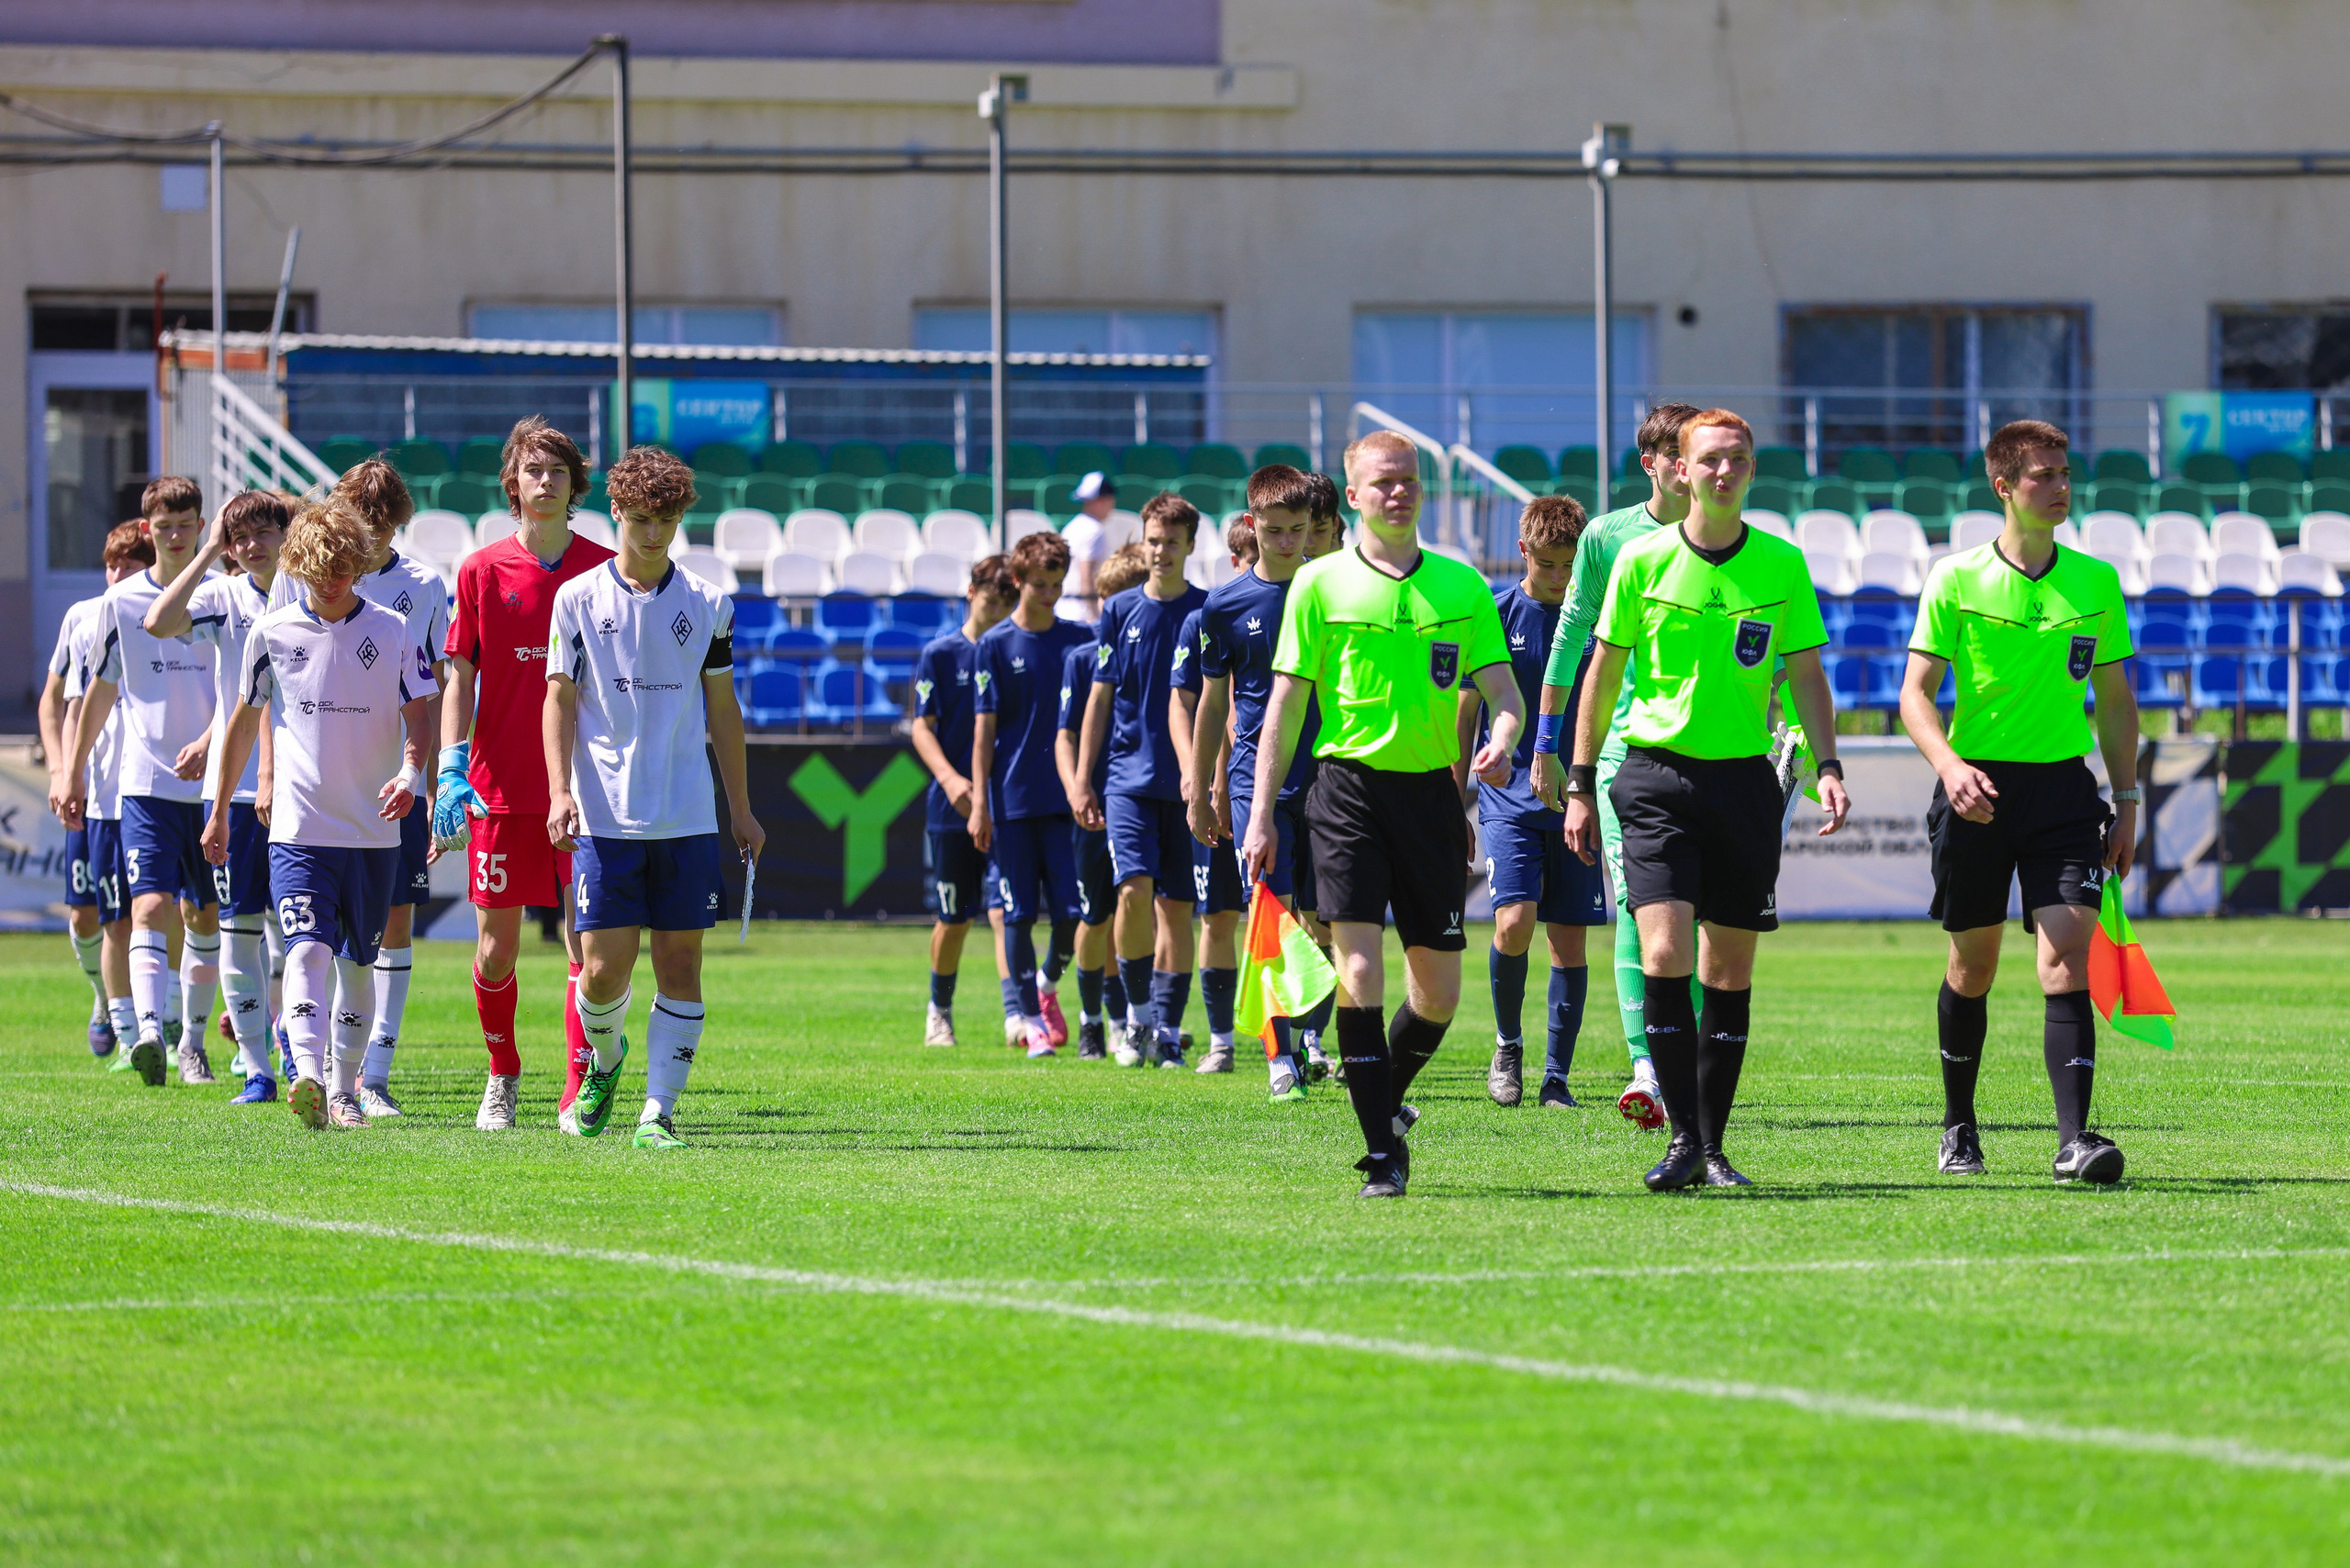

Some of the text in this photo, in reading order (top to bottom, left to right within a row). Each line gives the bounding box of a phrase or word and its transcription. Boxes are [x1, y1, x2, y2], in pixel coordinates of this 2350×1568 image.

[1742, 624, 1768, 633] РОССИЯ
[318, 706, 371, 714] ТРАНССТРОЙ
[476, 850, 508, 893] 35
[576, 873, 590, 914] 4
[936, 880, 957, 915] 17
[999, 877, 1013, 913] 9
[279, 895, 317, 936] 63
[337, 1018, 363, 1027] KELME
[2065, 1057, 2094, 1069] JÖGE
